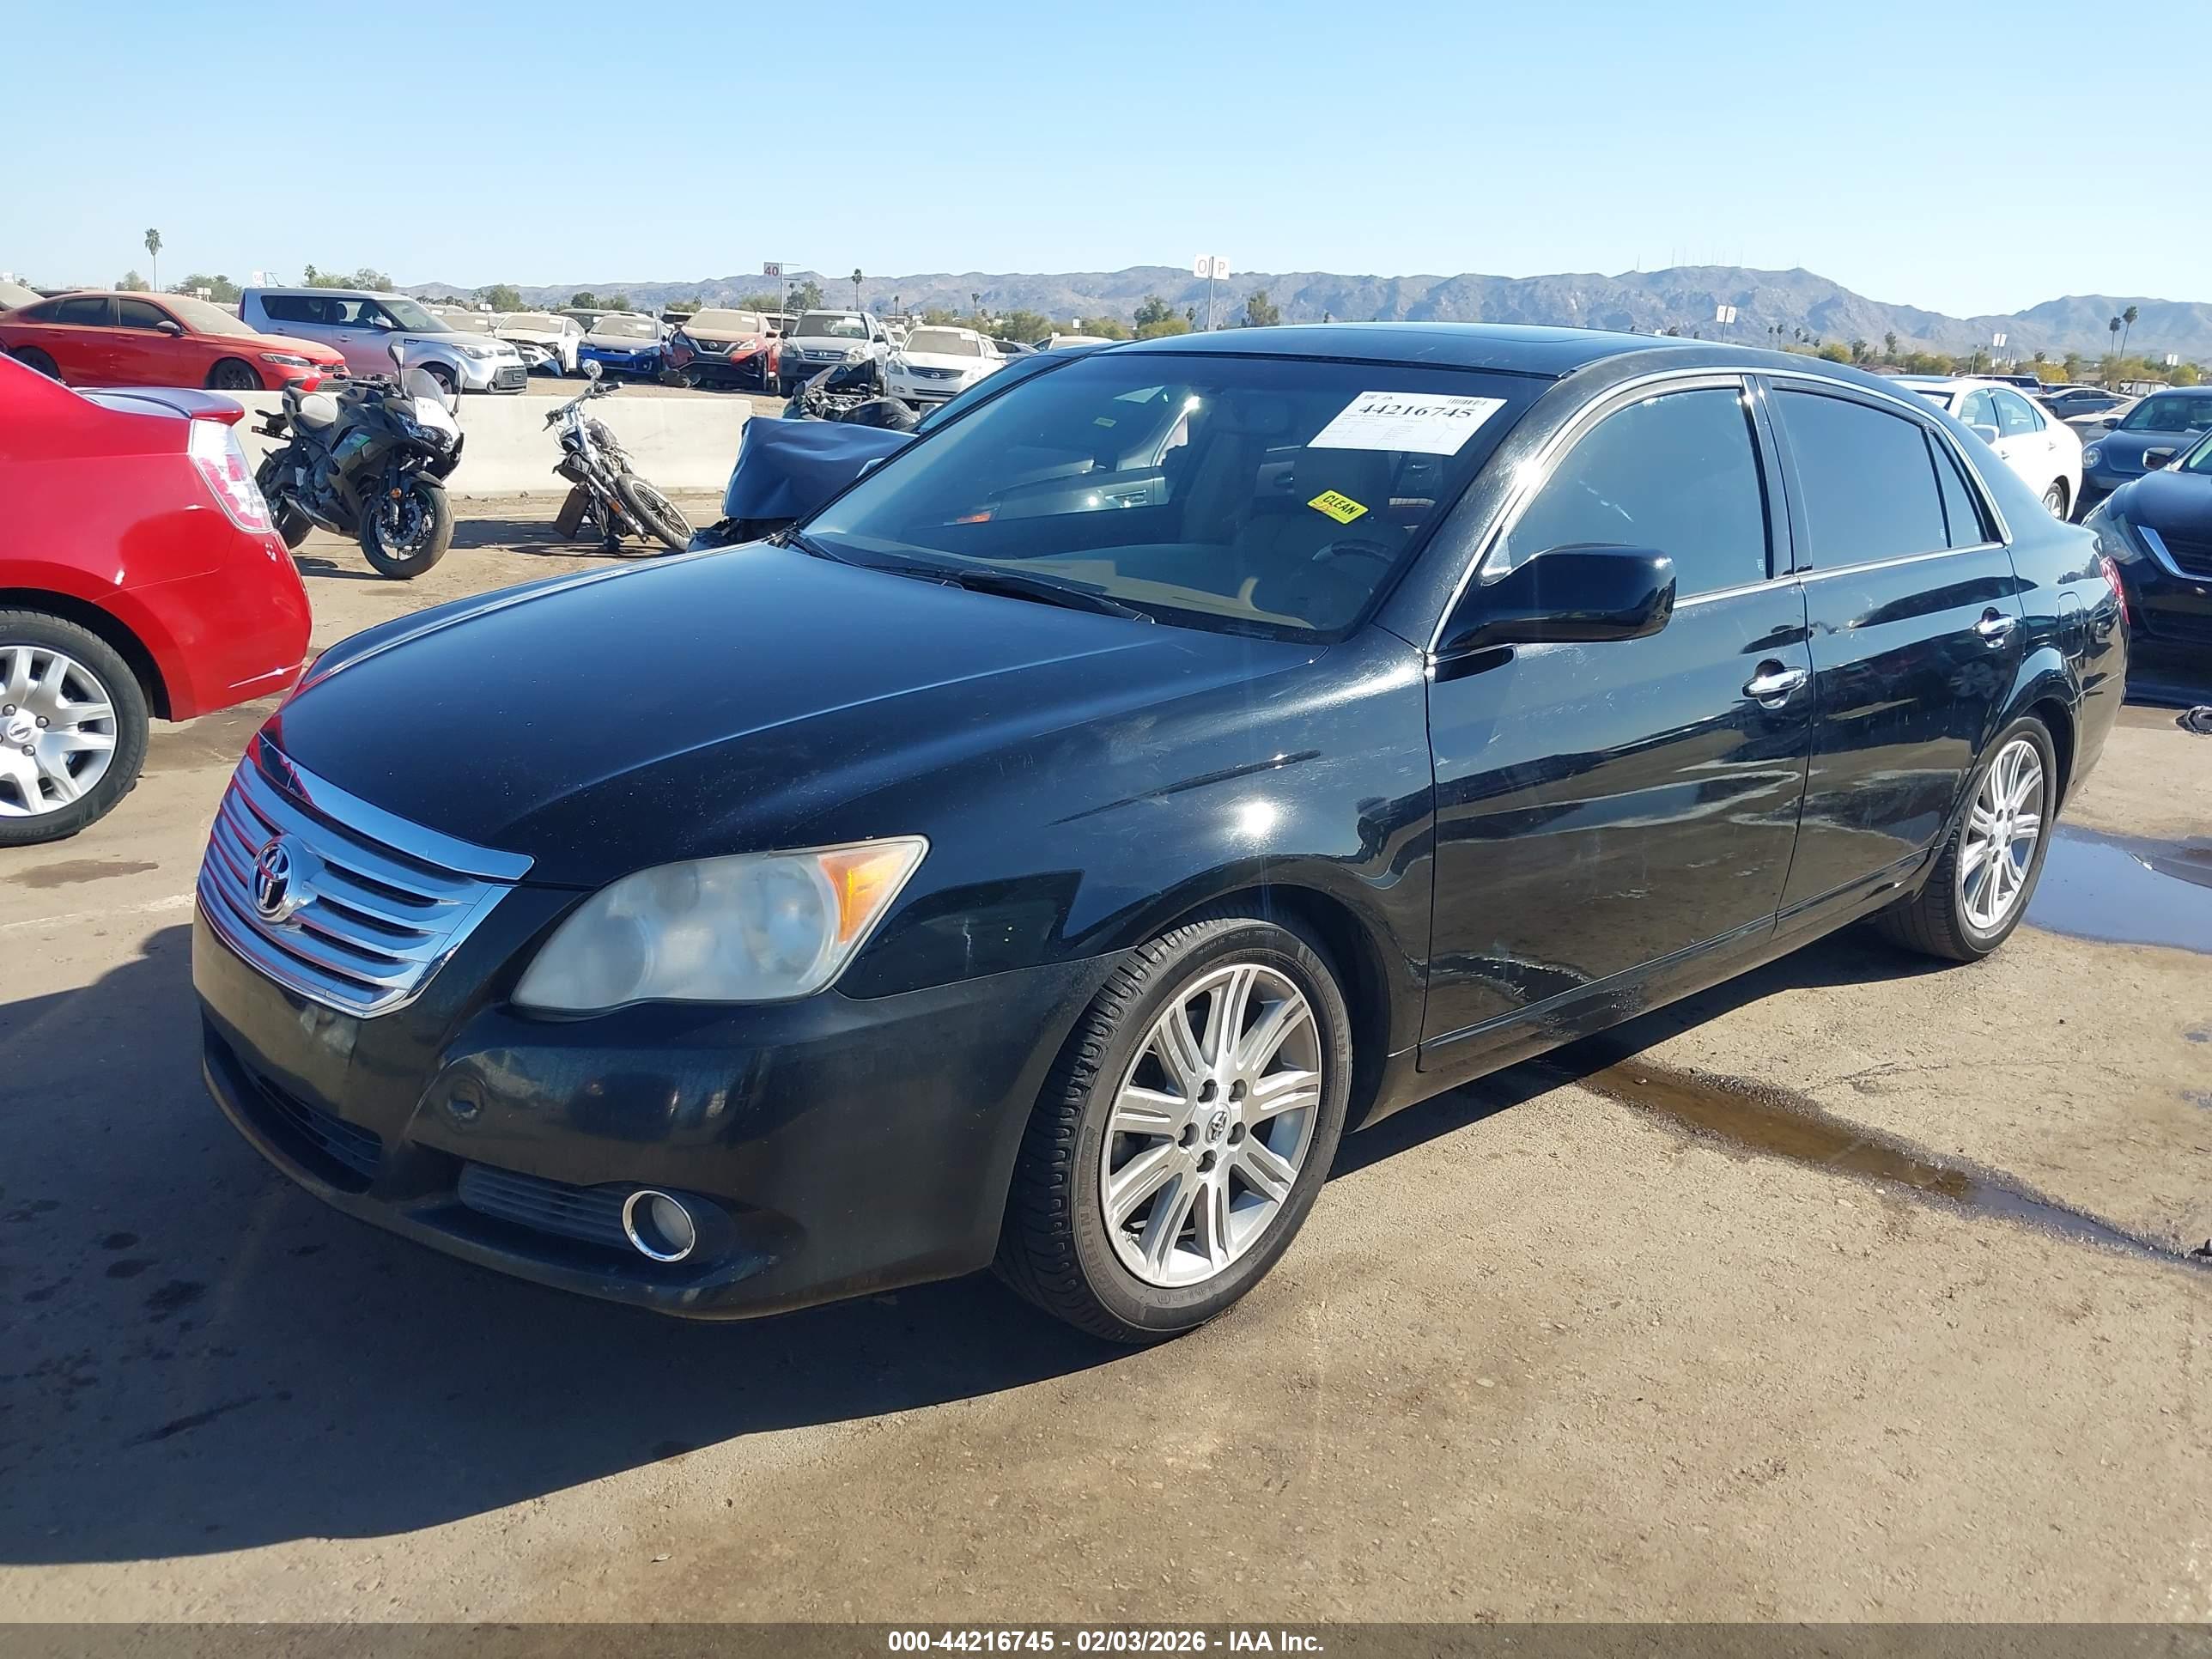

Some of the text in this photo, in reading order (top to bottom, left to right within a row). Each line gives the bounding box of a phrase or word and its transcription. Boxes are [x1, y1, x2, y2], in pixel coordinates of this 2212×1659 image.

[764, 266, 779, 276] 40
[1218, 261, 1226, 276] P
[1358, 404, 1476, 418] 44216745
[1322, 495, 1359, 515] CLEAN
